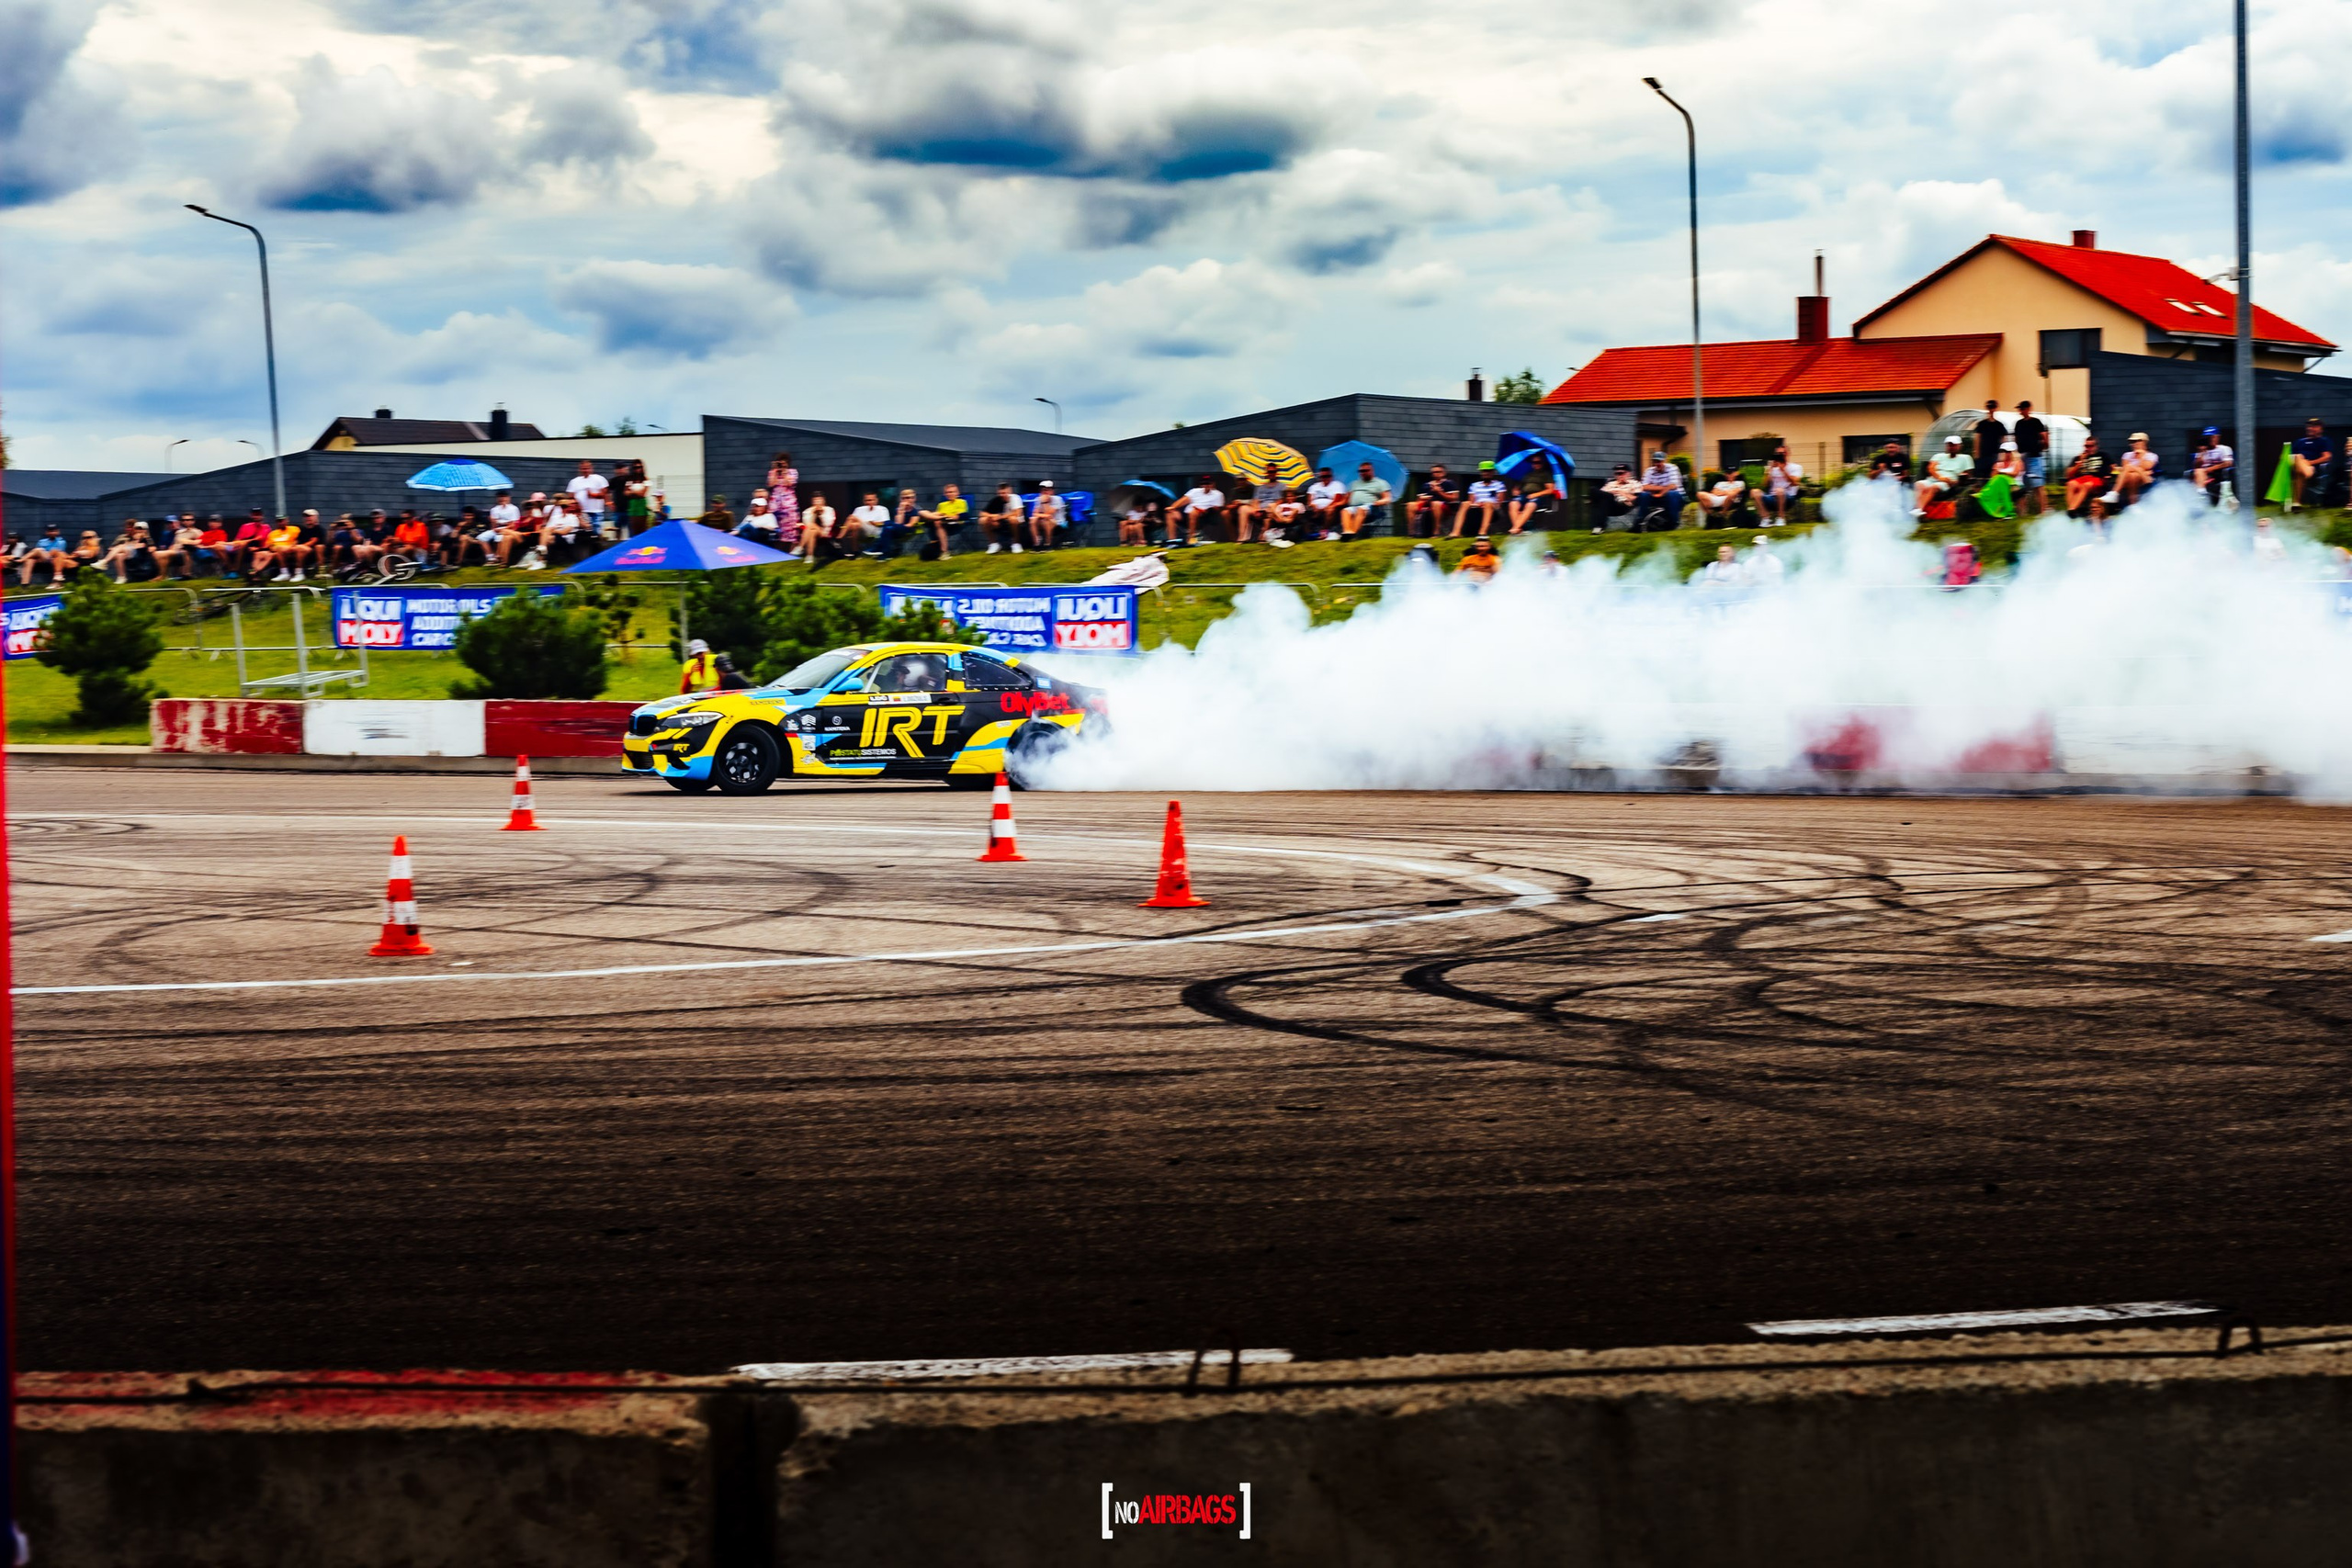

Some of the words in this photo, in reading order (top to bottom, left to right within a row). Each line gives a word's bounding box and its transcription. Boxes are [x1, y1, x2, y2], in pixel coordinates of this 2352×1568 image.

[341, 598, 402, 621] LQUI
[1000, 692, 1070, 717] OlyBet
[859, 705, 966, 759] IRT
